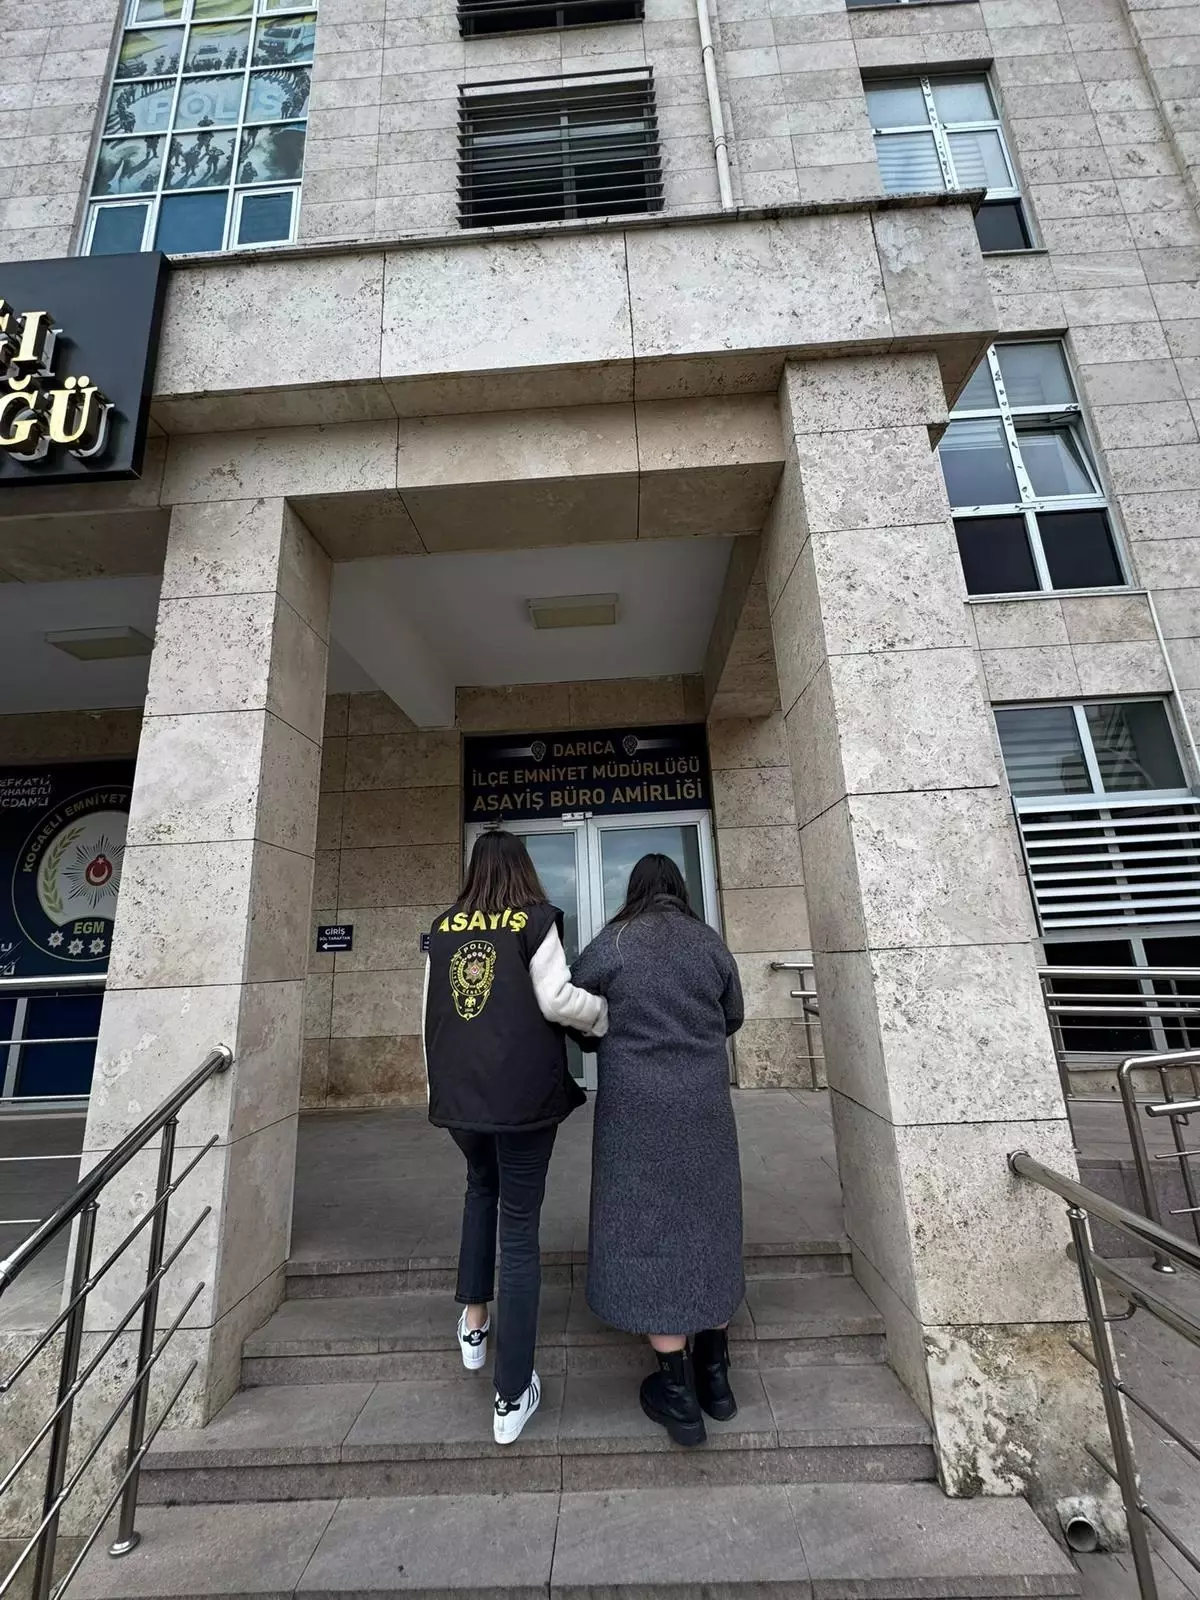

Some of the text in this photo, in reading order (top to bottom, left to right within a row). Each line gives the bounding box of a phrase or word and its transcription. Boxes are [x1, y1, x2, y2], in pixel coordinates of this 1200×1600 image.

[553, 740, 616, 758] DARICA
[472, 755, 701, 788] İLÇE EMNİYET MÜDÜRLÜĞÜ
[473, 778, 703, 812] ASAYİŞ BÜRO AMİRLİĞİ
[22, 793, 128, 873] KOCAELİ EMNİYET
[73, 921, 105, 935] EGM
[437, 907, 529, 932] ASAYİŞ
